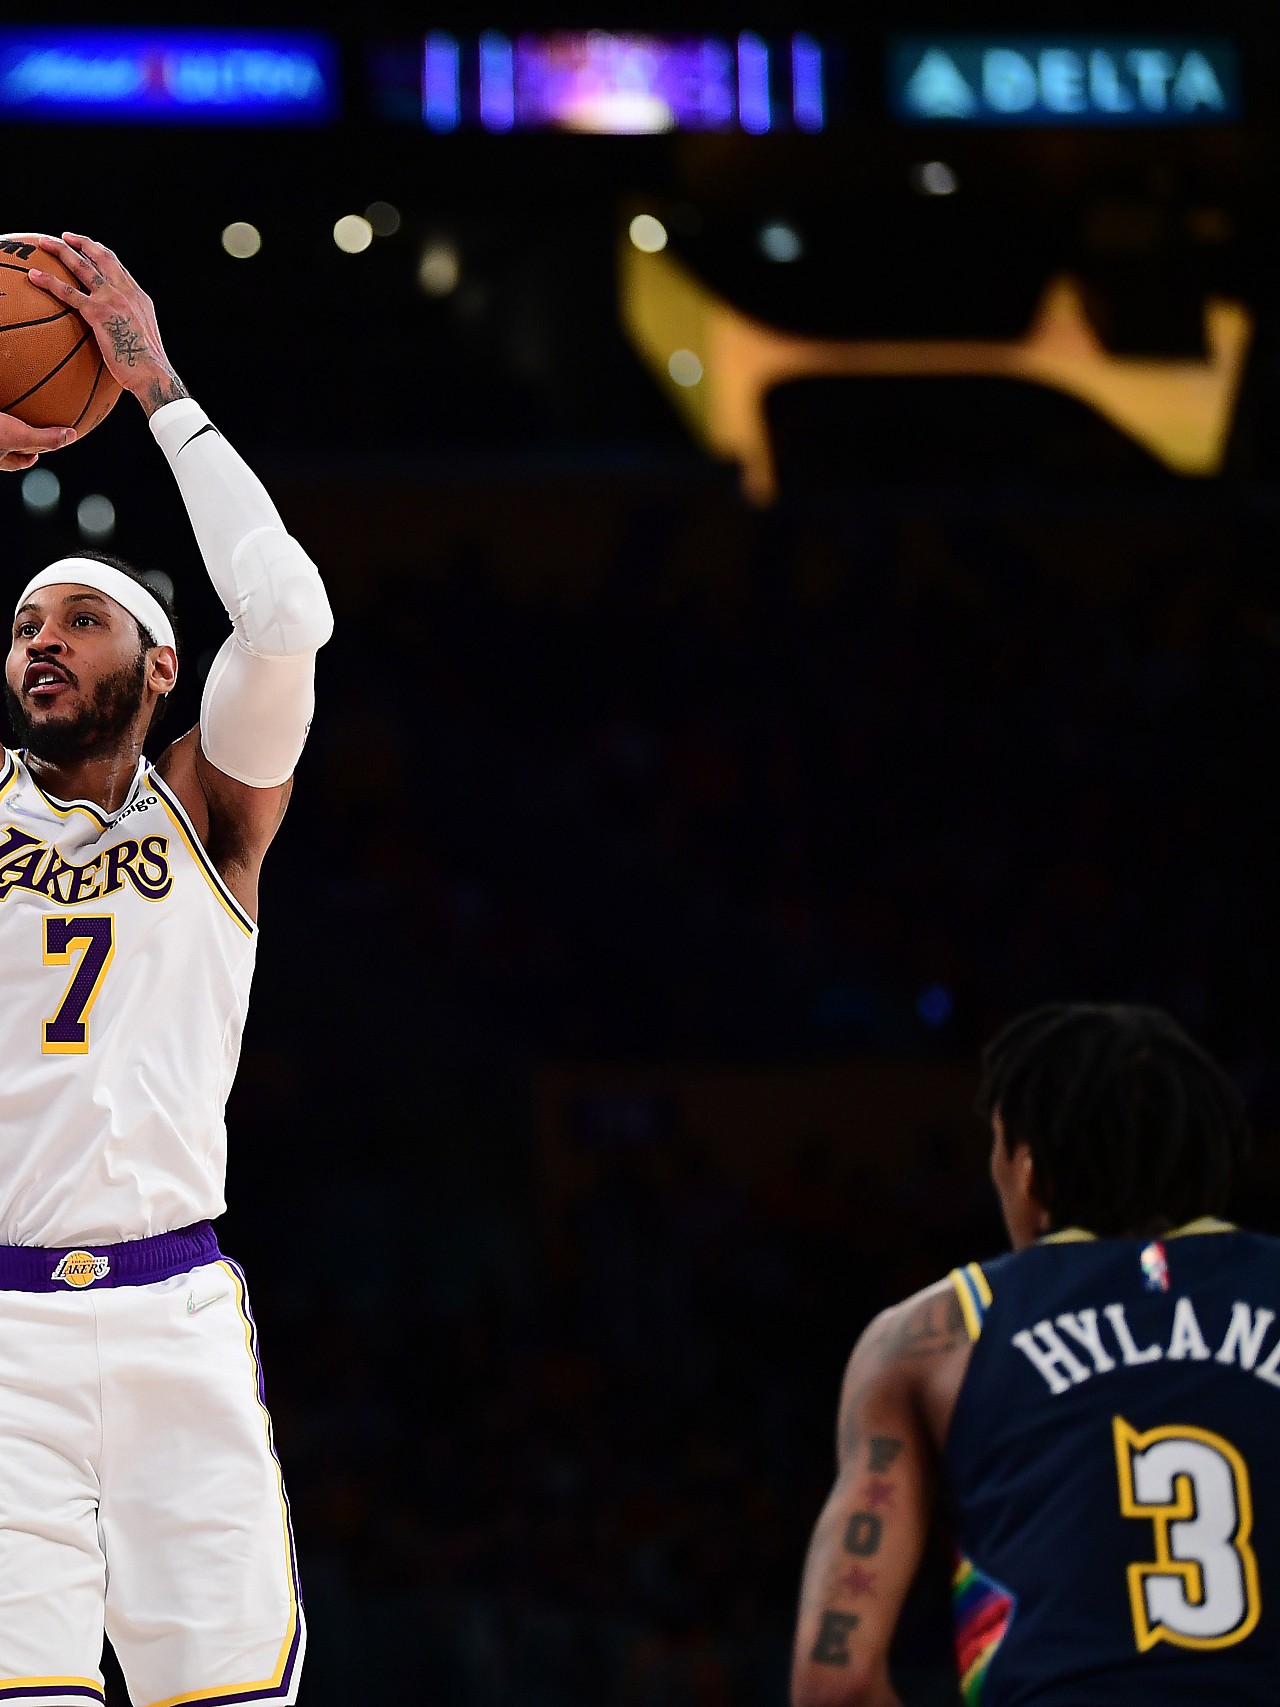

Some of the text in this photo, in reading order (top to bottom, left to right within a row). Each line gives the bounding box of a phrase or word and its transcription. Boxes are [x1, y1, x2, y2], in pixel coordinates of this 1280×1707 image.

[981, 47, 1225, 114] DELTA
[41, 913, 115, 1055] 7
[53, 1259, 108, 1279] LAKERS
[1113, 1415, 1262, 1654] 3
